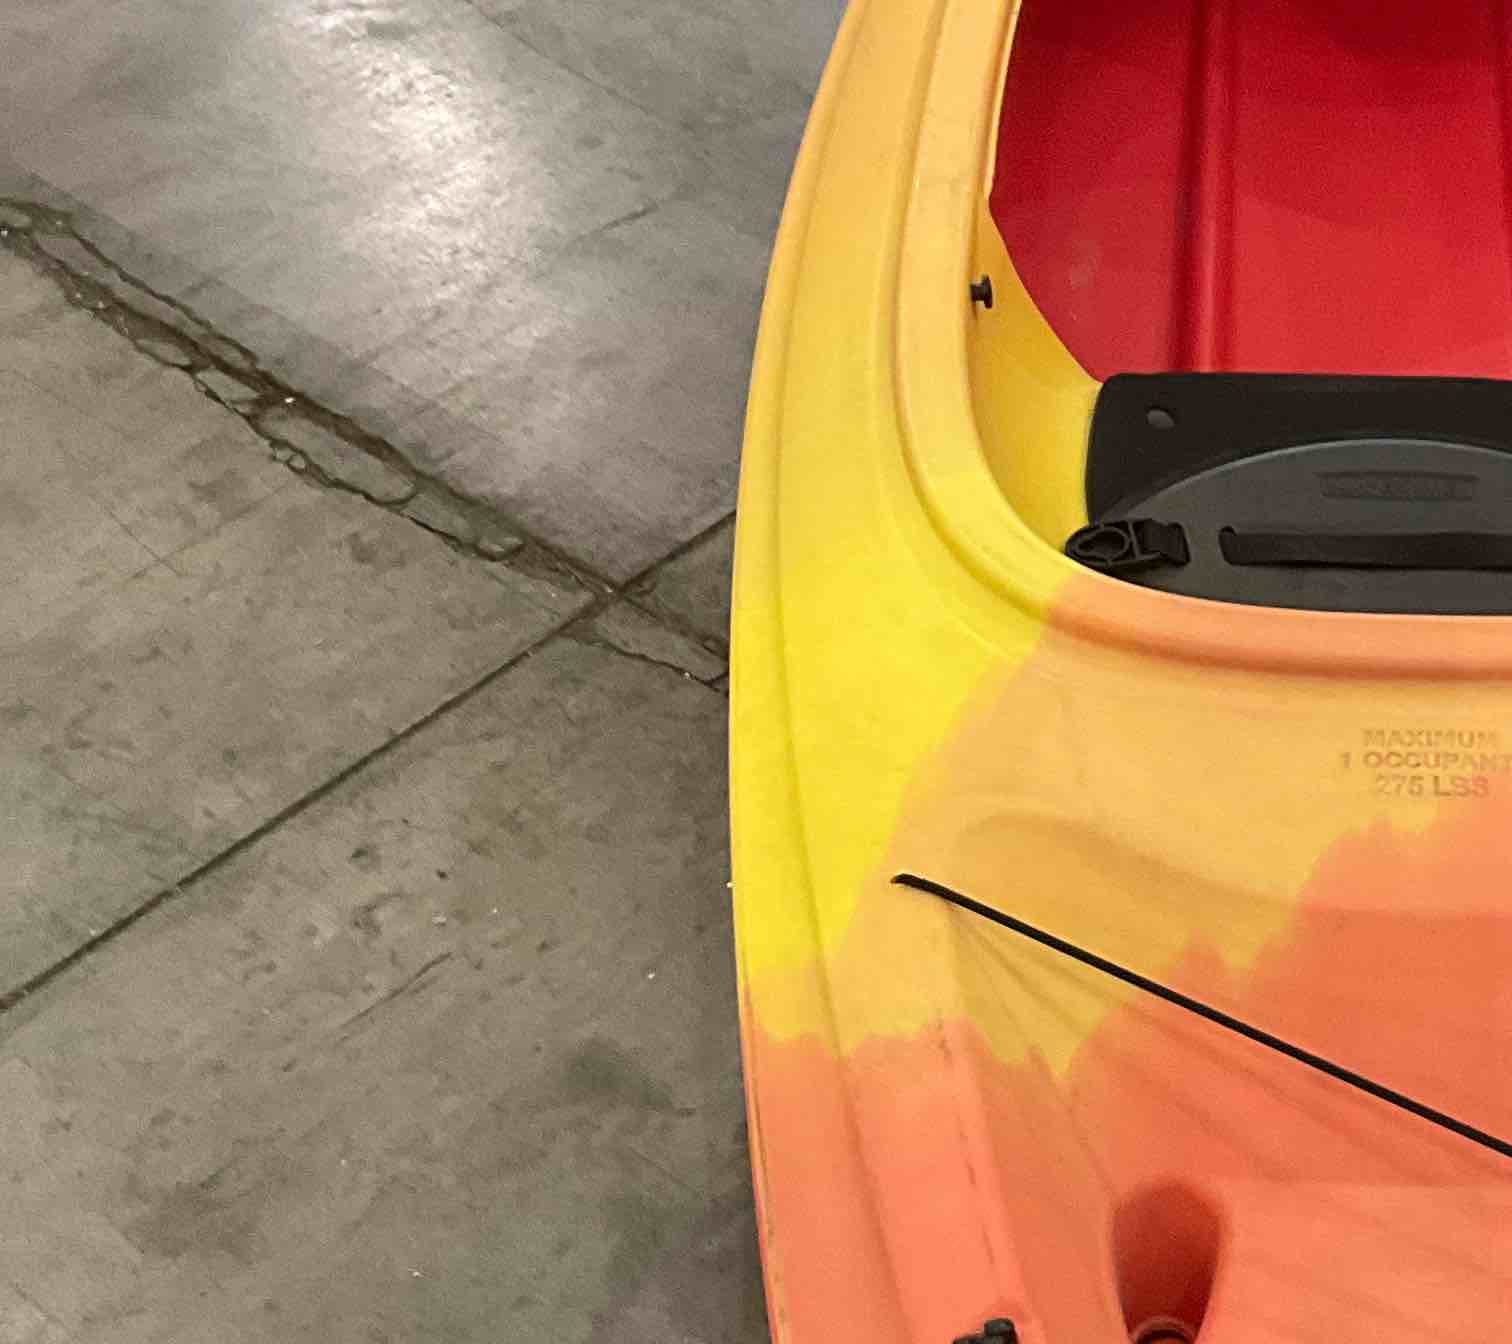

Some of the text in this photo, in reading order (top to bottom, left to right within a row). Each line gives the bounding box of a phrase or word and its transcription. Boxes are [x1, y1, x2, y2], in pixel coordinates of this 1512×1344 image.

[1361, 728, 1498, 749] MAXIMUM
[1339, 752, 1352, 769] 1
[1375, 774, 1424, 796] 275
